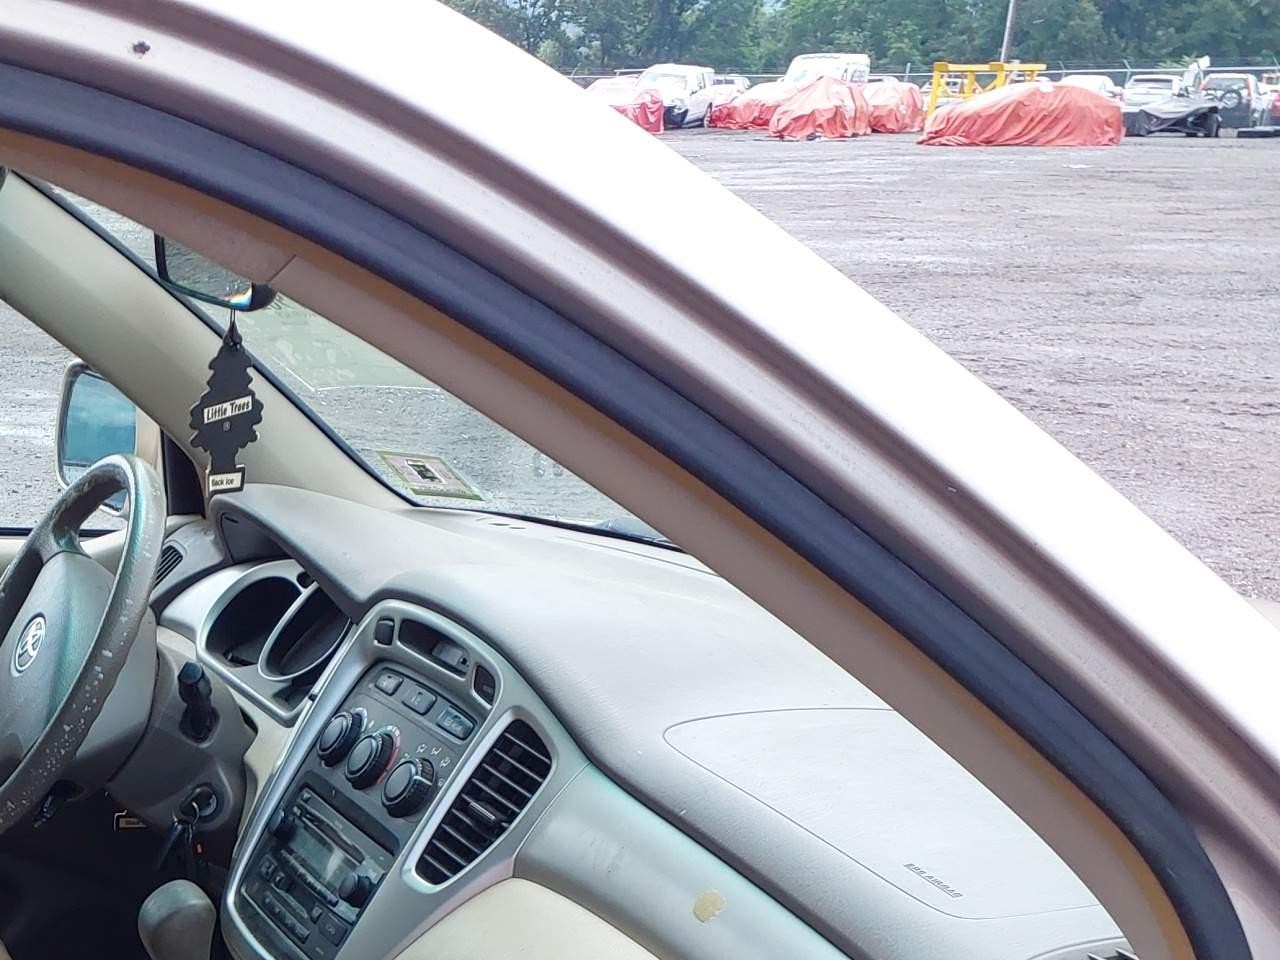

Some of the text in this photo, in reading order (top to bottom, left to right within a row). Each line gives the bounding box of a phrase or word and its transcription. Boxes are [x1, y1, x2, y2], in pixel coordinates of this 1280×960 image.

[207, 401, 250, 420] Little Trees
[924, 875, 964, 898] AIRBAG
